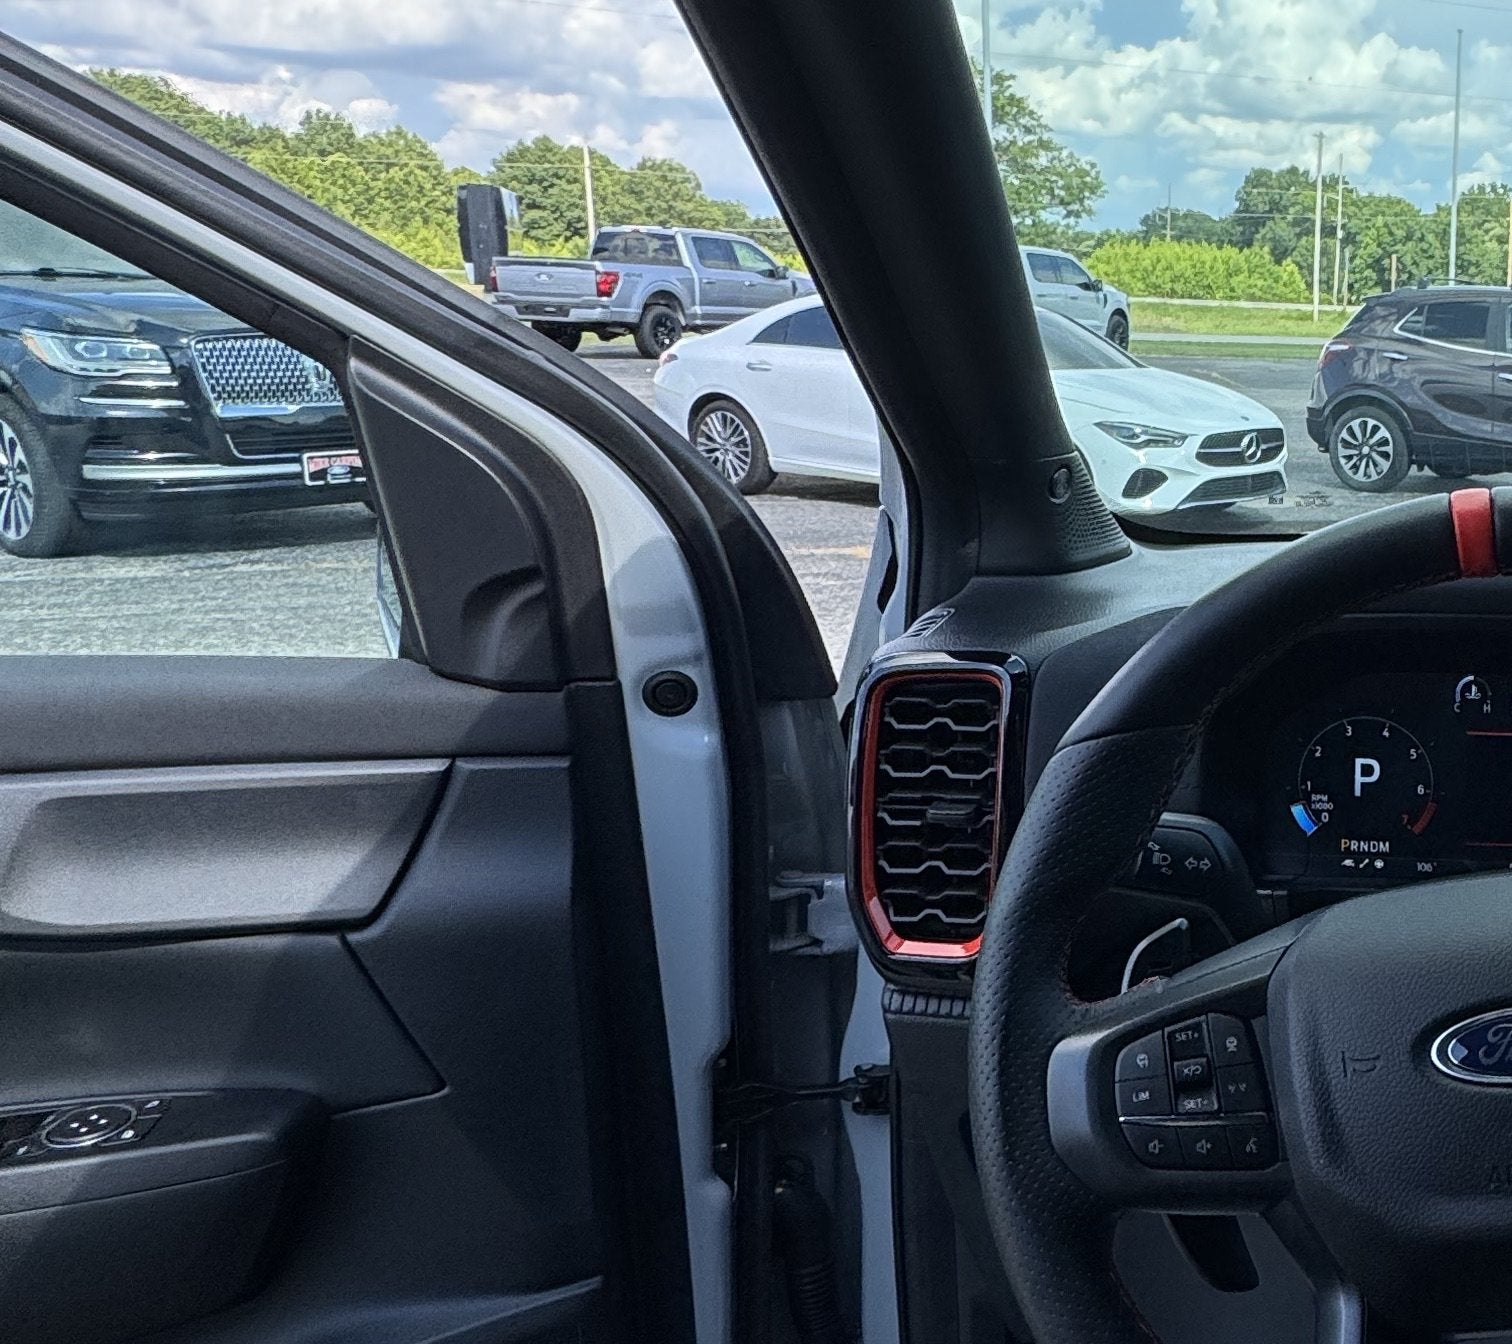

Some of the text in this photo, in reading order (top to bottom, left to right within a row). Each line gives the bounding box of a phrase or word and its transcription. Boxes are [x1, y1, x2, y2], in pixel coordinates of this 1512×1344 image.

[1345, 726, 1352, 736] 3
[1381, 728, 1389, 739] 4
[1314, 747, 1322, 757] 2
[1409, 748, 1417, 759] 5
[1353, 757, 1381, 797] P
[1417, 784, 1424, 795] 6
[1311, 794, 1328, 803] RPM
